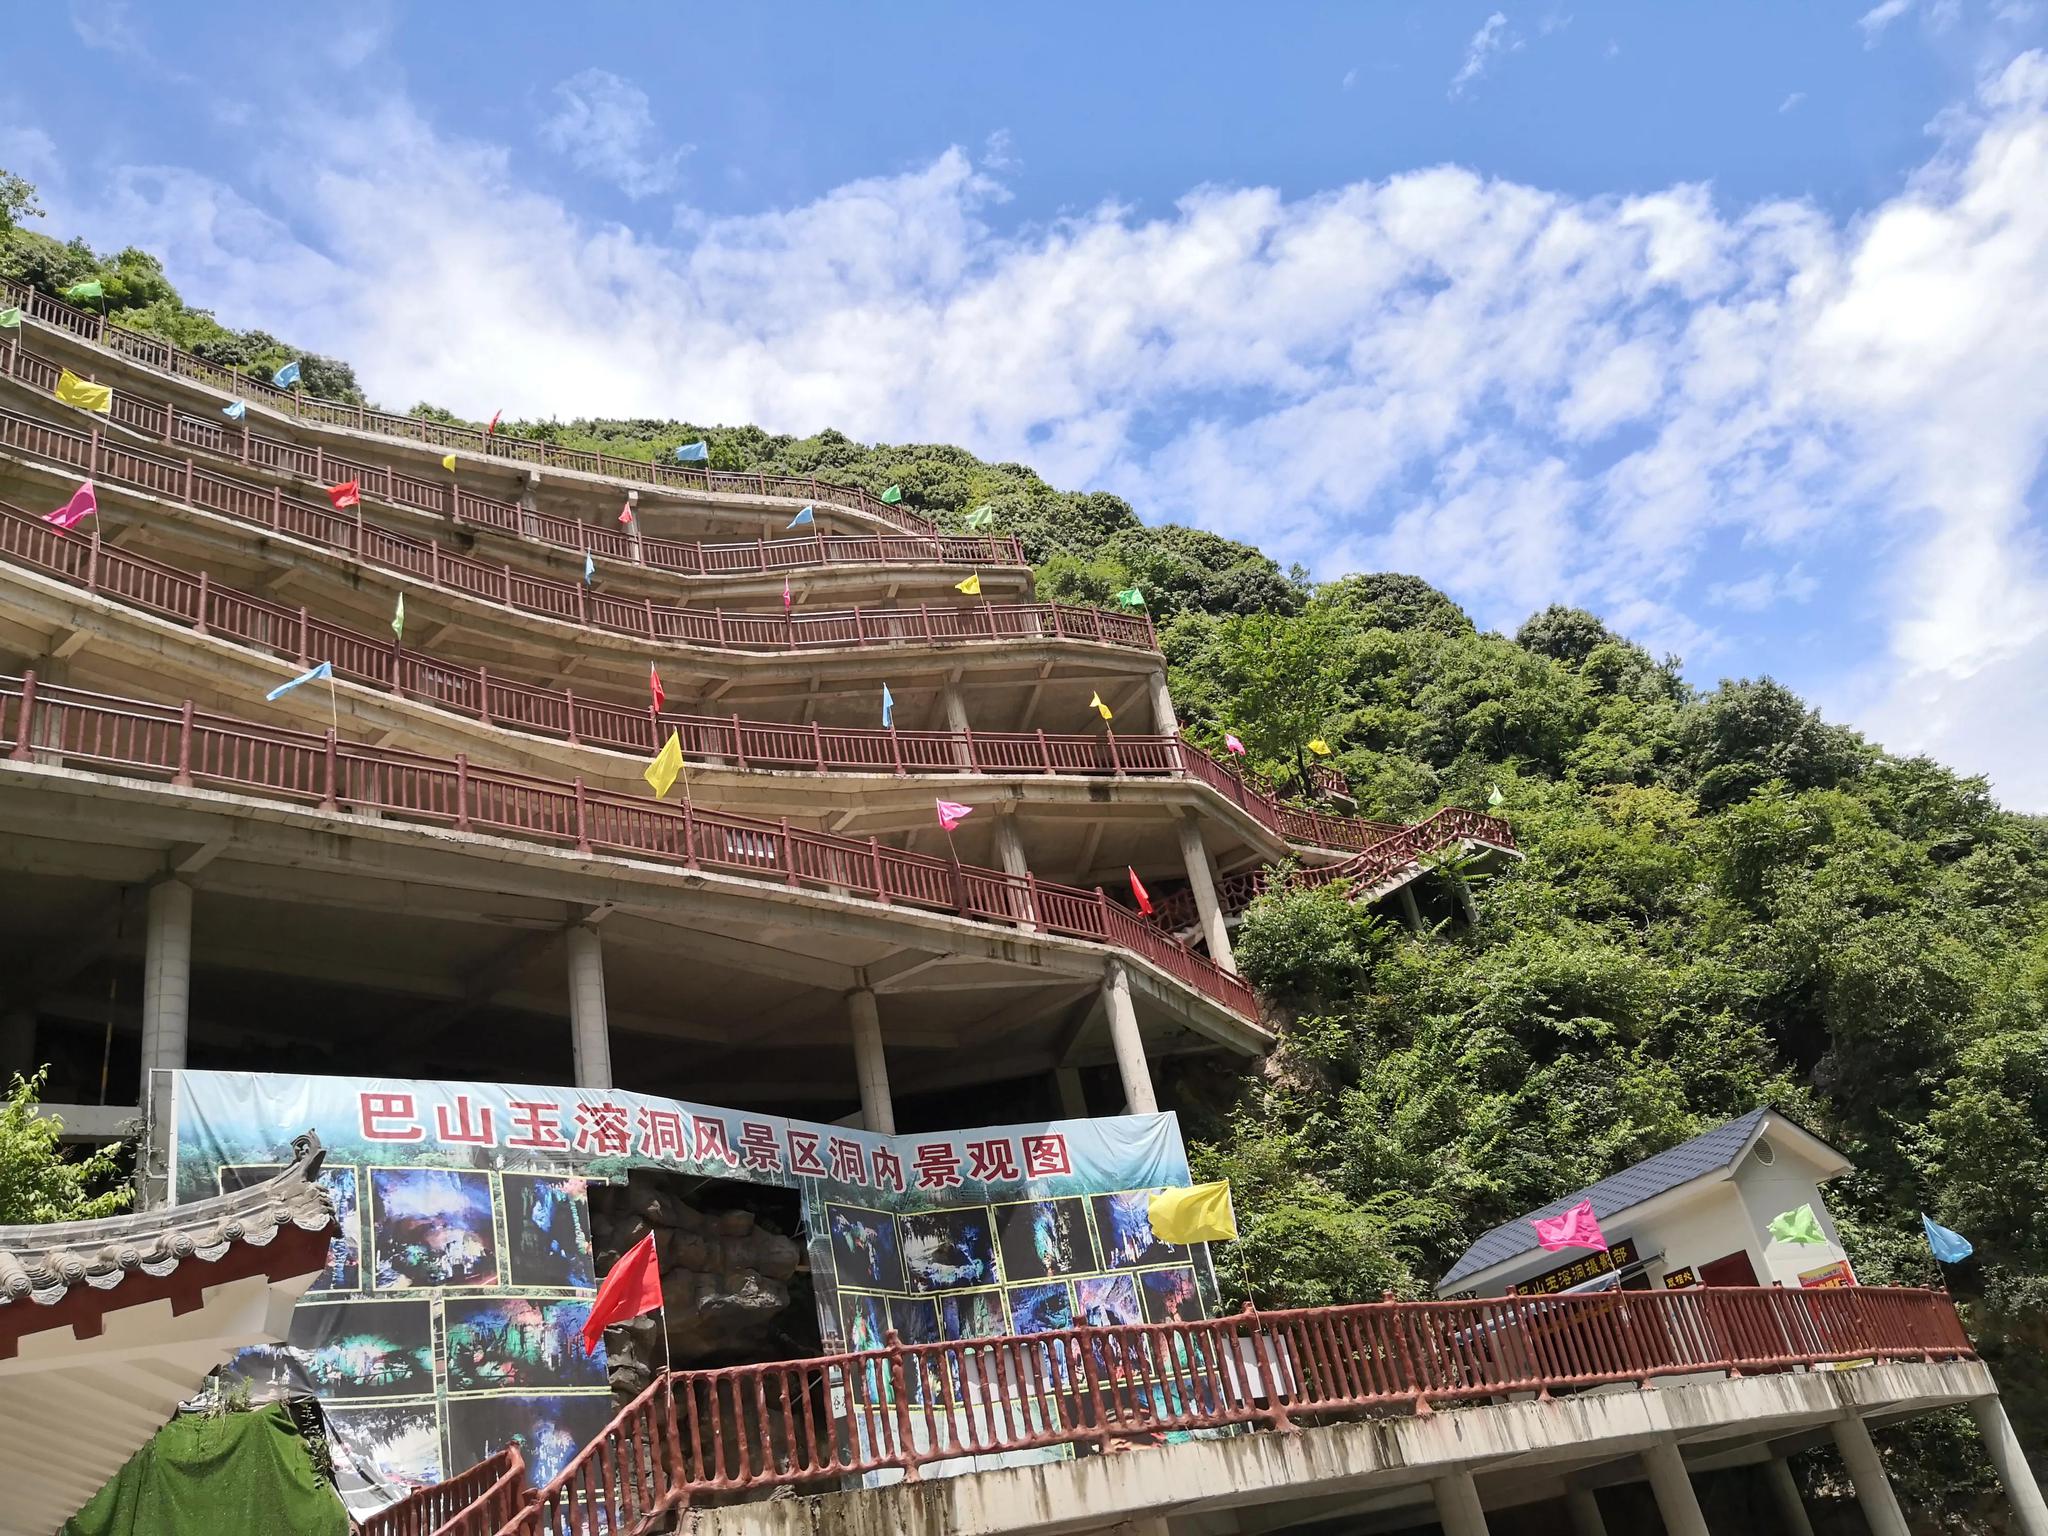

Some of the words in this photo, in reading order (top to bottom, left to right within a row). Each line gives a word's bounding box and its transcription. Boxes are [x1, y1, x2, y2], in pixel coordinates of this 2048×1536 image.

[359, 1092, 1072, 1192] 巴山玉溶洞风景区洞内景观图
